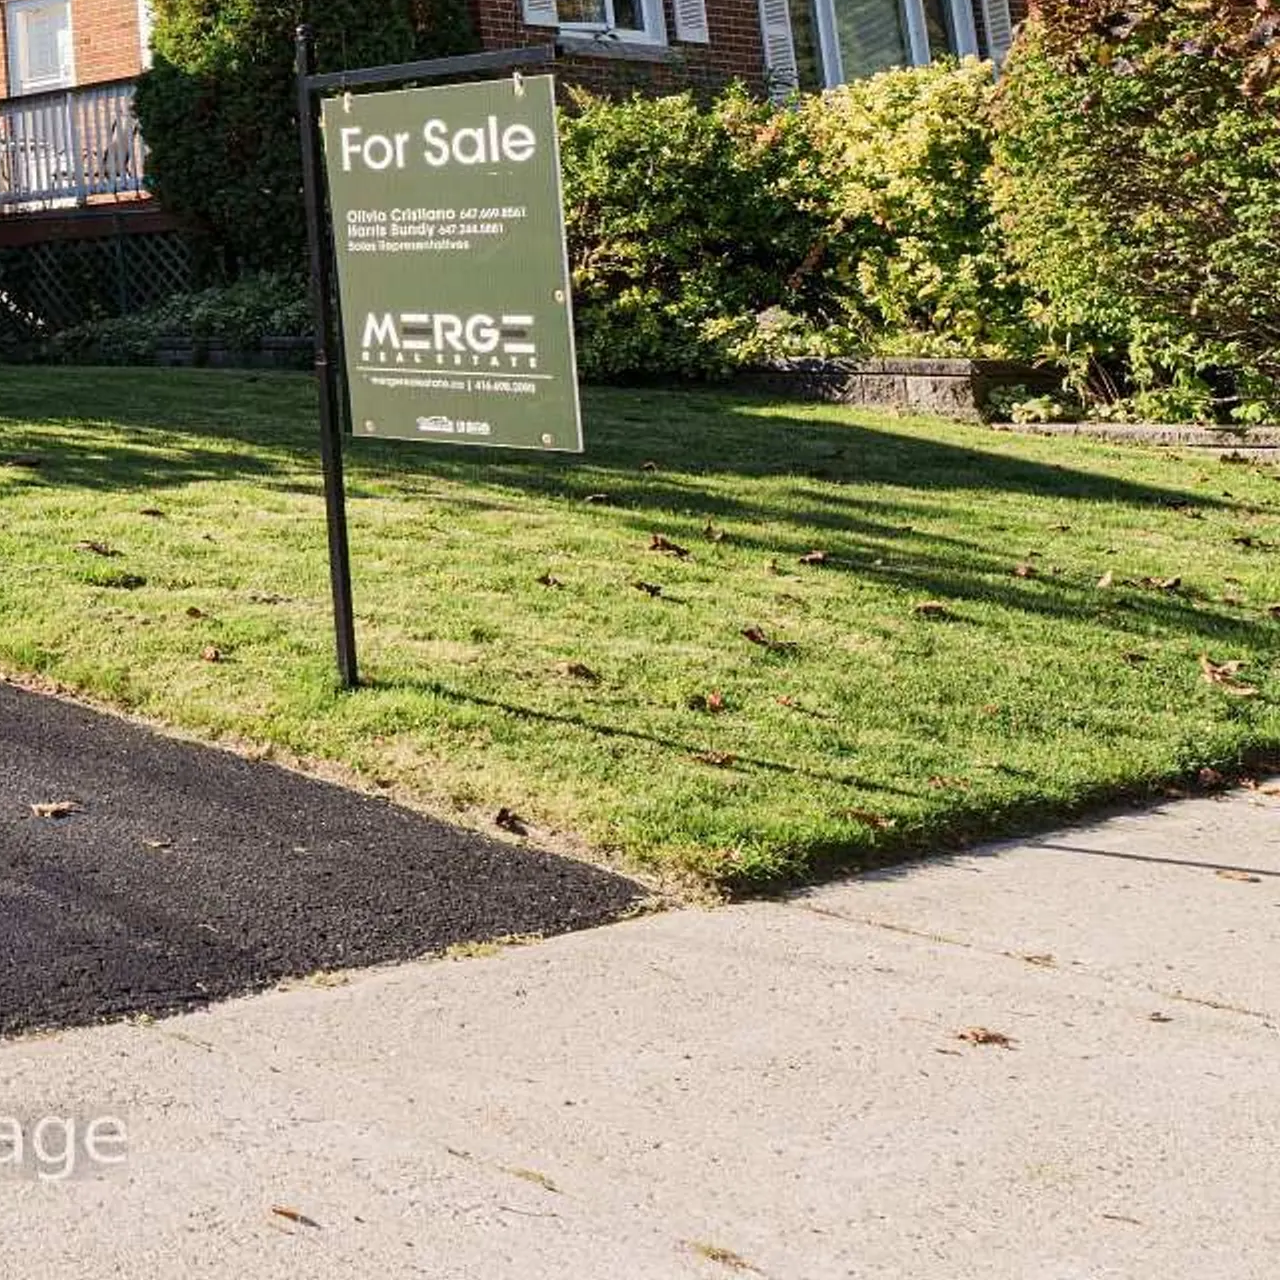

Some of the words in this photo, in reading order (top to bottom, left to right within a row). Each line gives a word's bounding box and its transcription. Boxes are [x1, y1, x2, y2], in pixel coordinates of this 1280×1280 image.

[340, 126, 410, 171] For
[423, 115, 537, 167] Sale
[362, 312, 536, 354] MERGE
